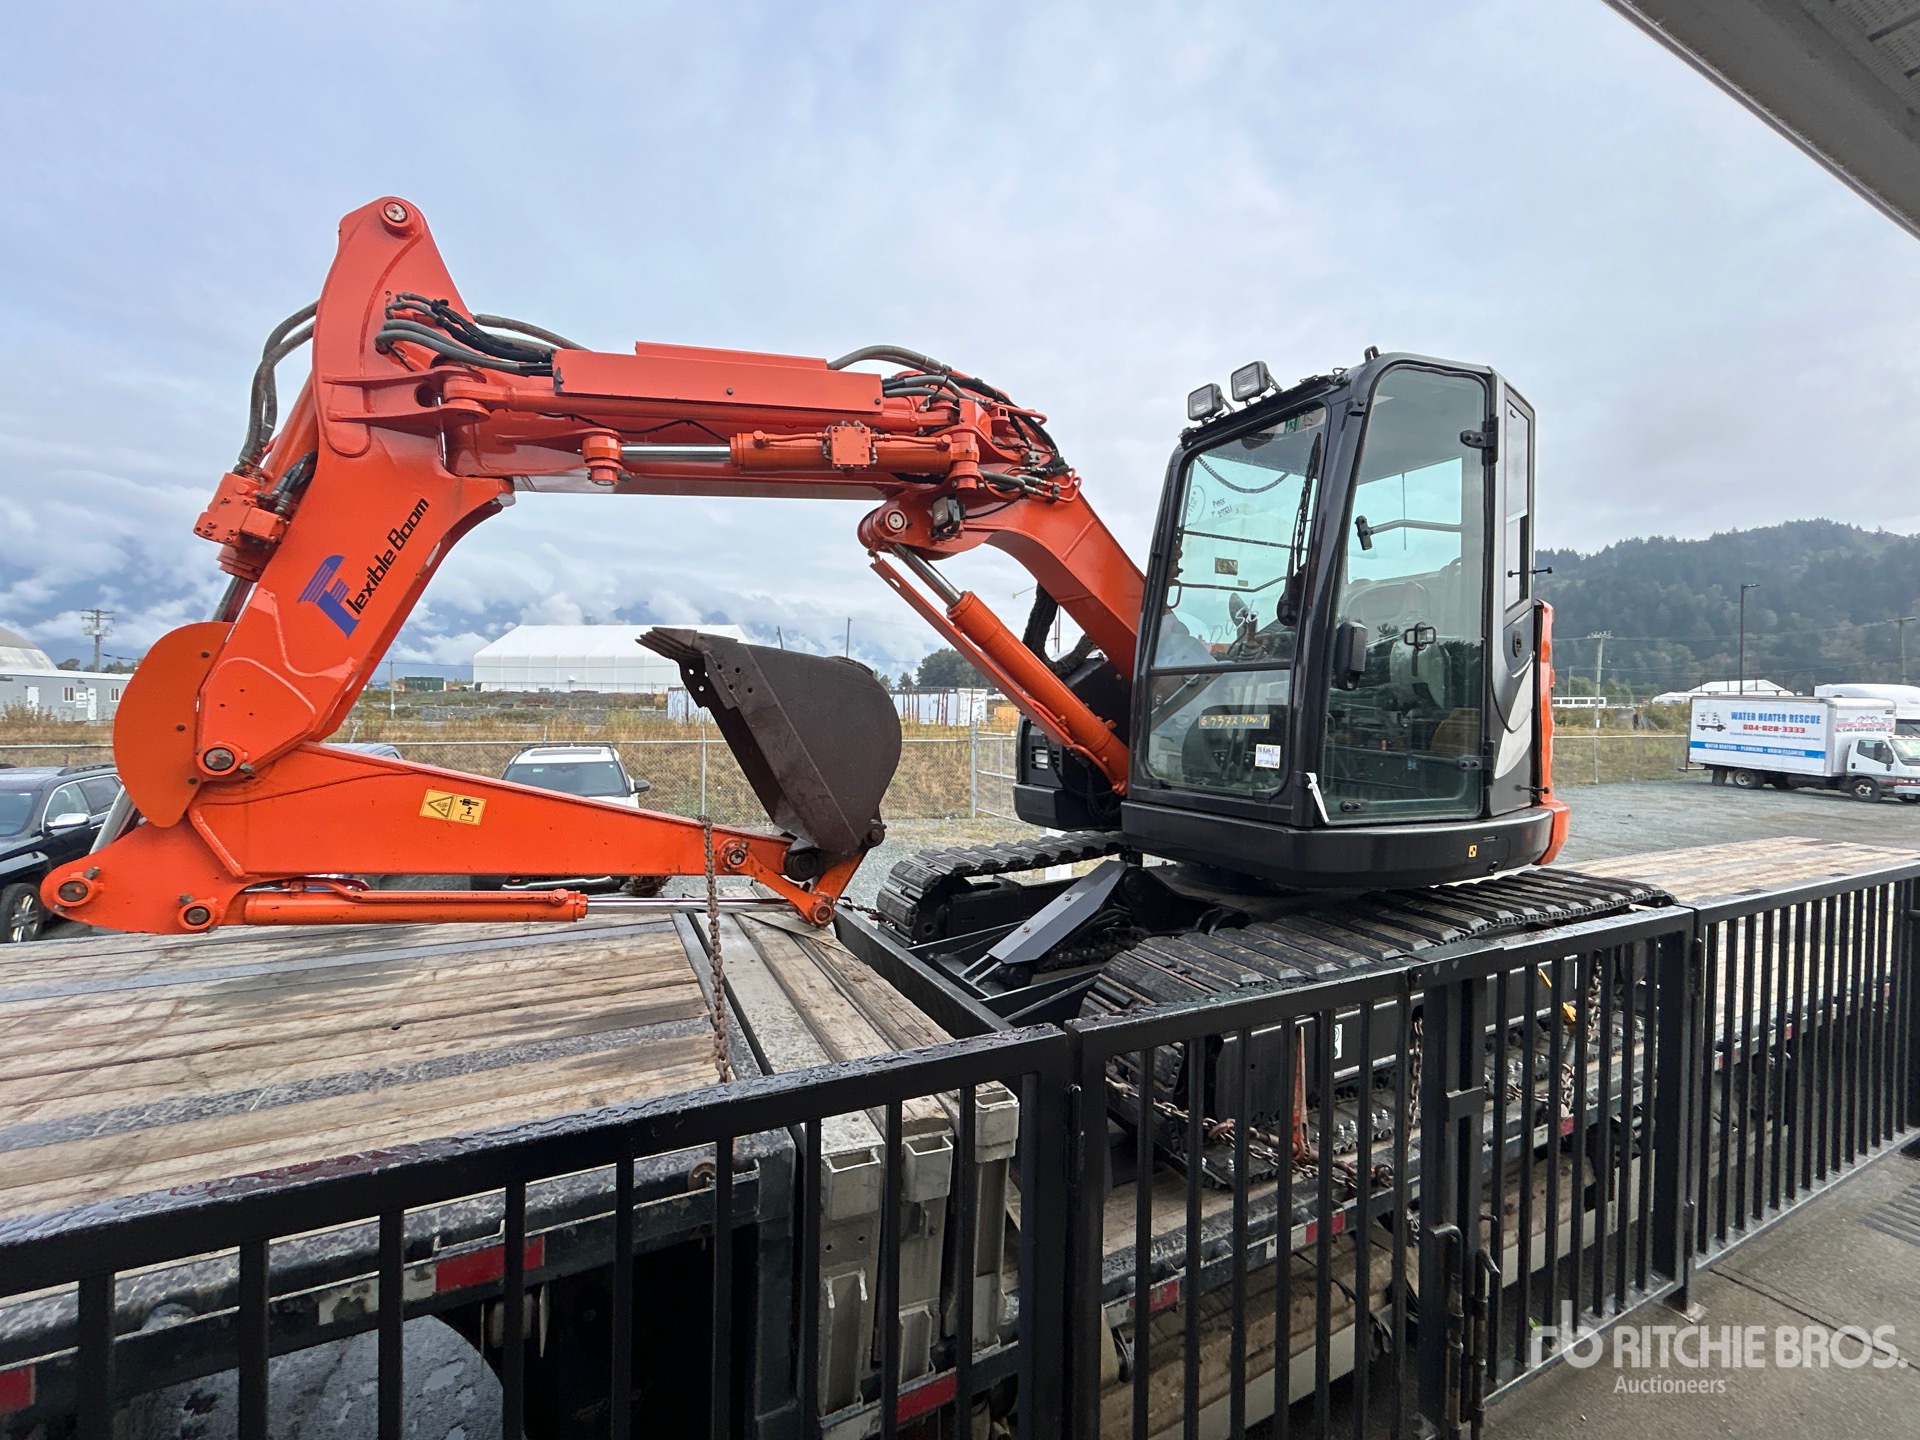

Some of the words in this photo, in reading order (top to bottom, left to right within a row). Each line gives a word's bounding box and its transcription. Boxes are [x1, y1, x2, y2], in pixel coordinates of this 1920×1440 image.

[386, 498, 430, 551] Boom
[1731, 711, 1756, 721] WATER
[1758, 712, 1787, 722] HEATER
[1789, 714, 1821, 724] RESCUE
